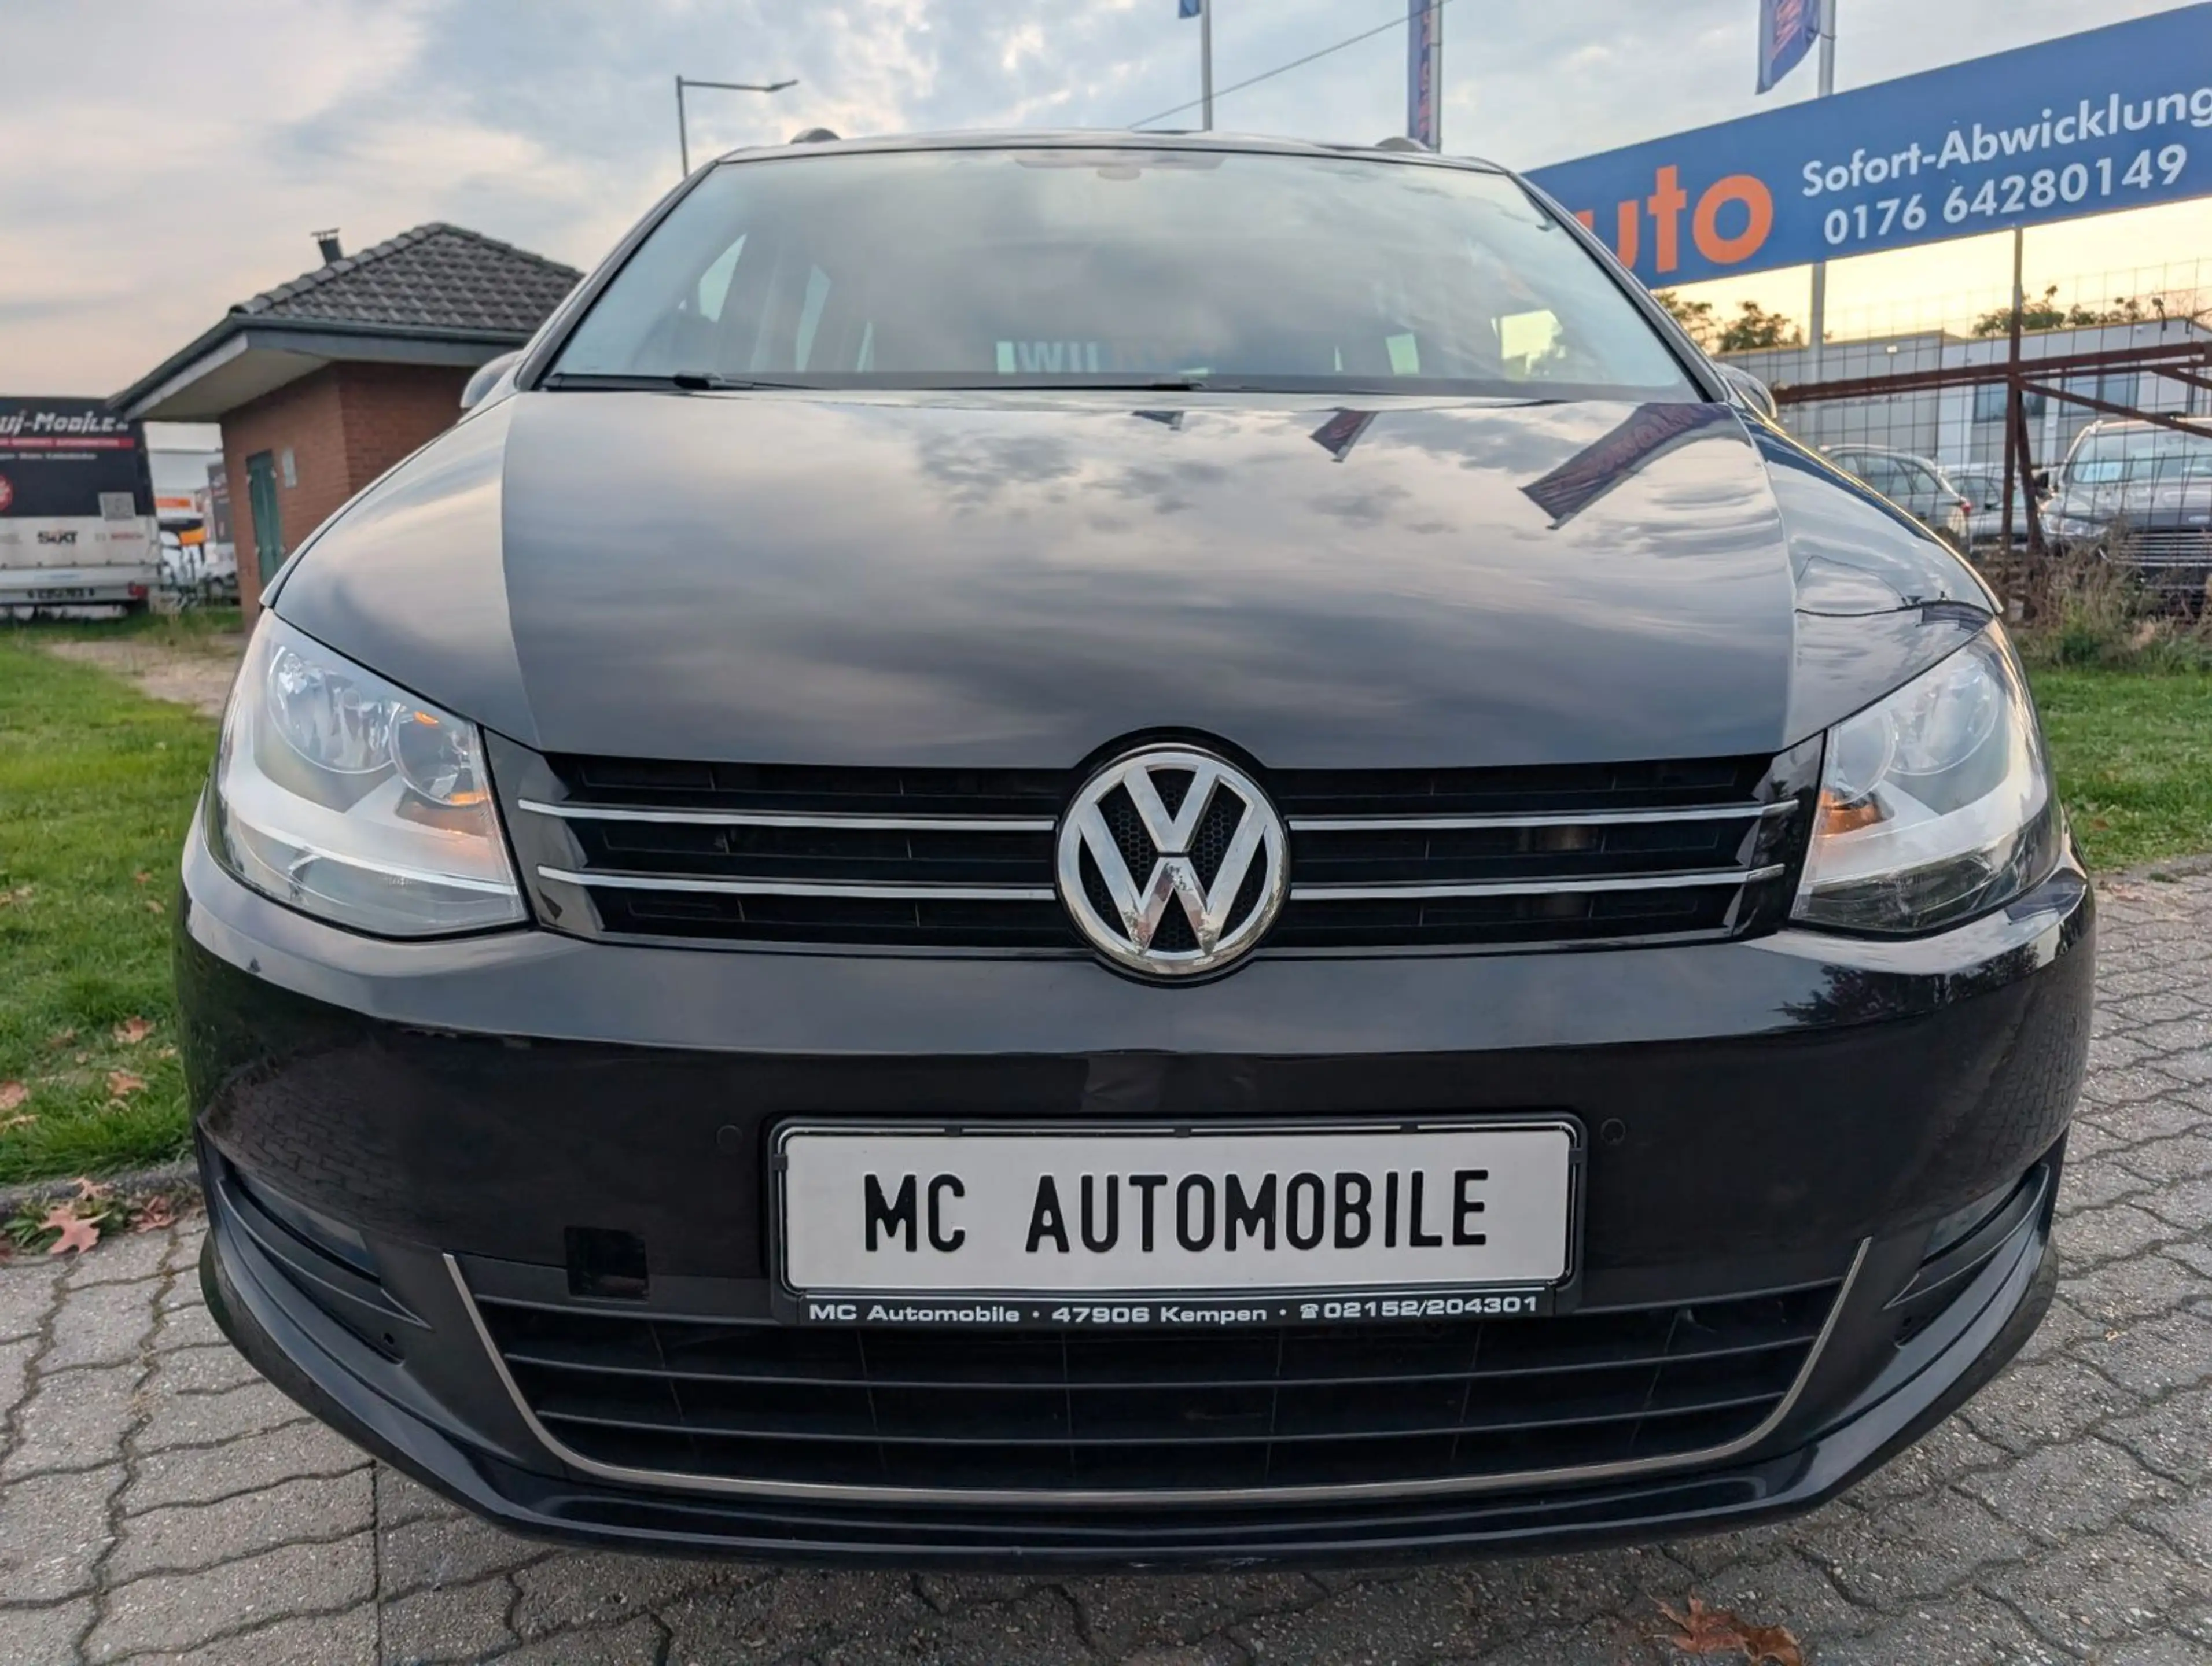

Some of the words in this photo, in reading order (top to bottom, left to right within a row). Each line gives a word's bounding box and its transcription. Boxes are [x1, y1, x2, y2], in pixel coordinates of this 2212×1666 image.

[1801, 87, 2212, 197] Sofort-Abwicklung
[1824, 193, 1927, 245] 0176
[1943, 143, 2187, 223] 64280149
[864, 1173, 966, 1253] MC
[1025, 1169, 1489, 1253] AUTOMOBILE
[809, 1304, 857, 1321] MC
[867, 1304, 1021, 1323] Automobile
[1051, 1307, 1151, 1324] 47906
[1160, 1306, 1267, 1325] Kempen
